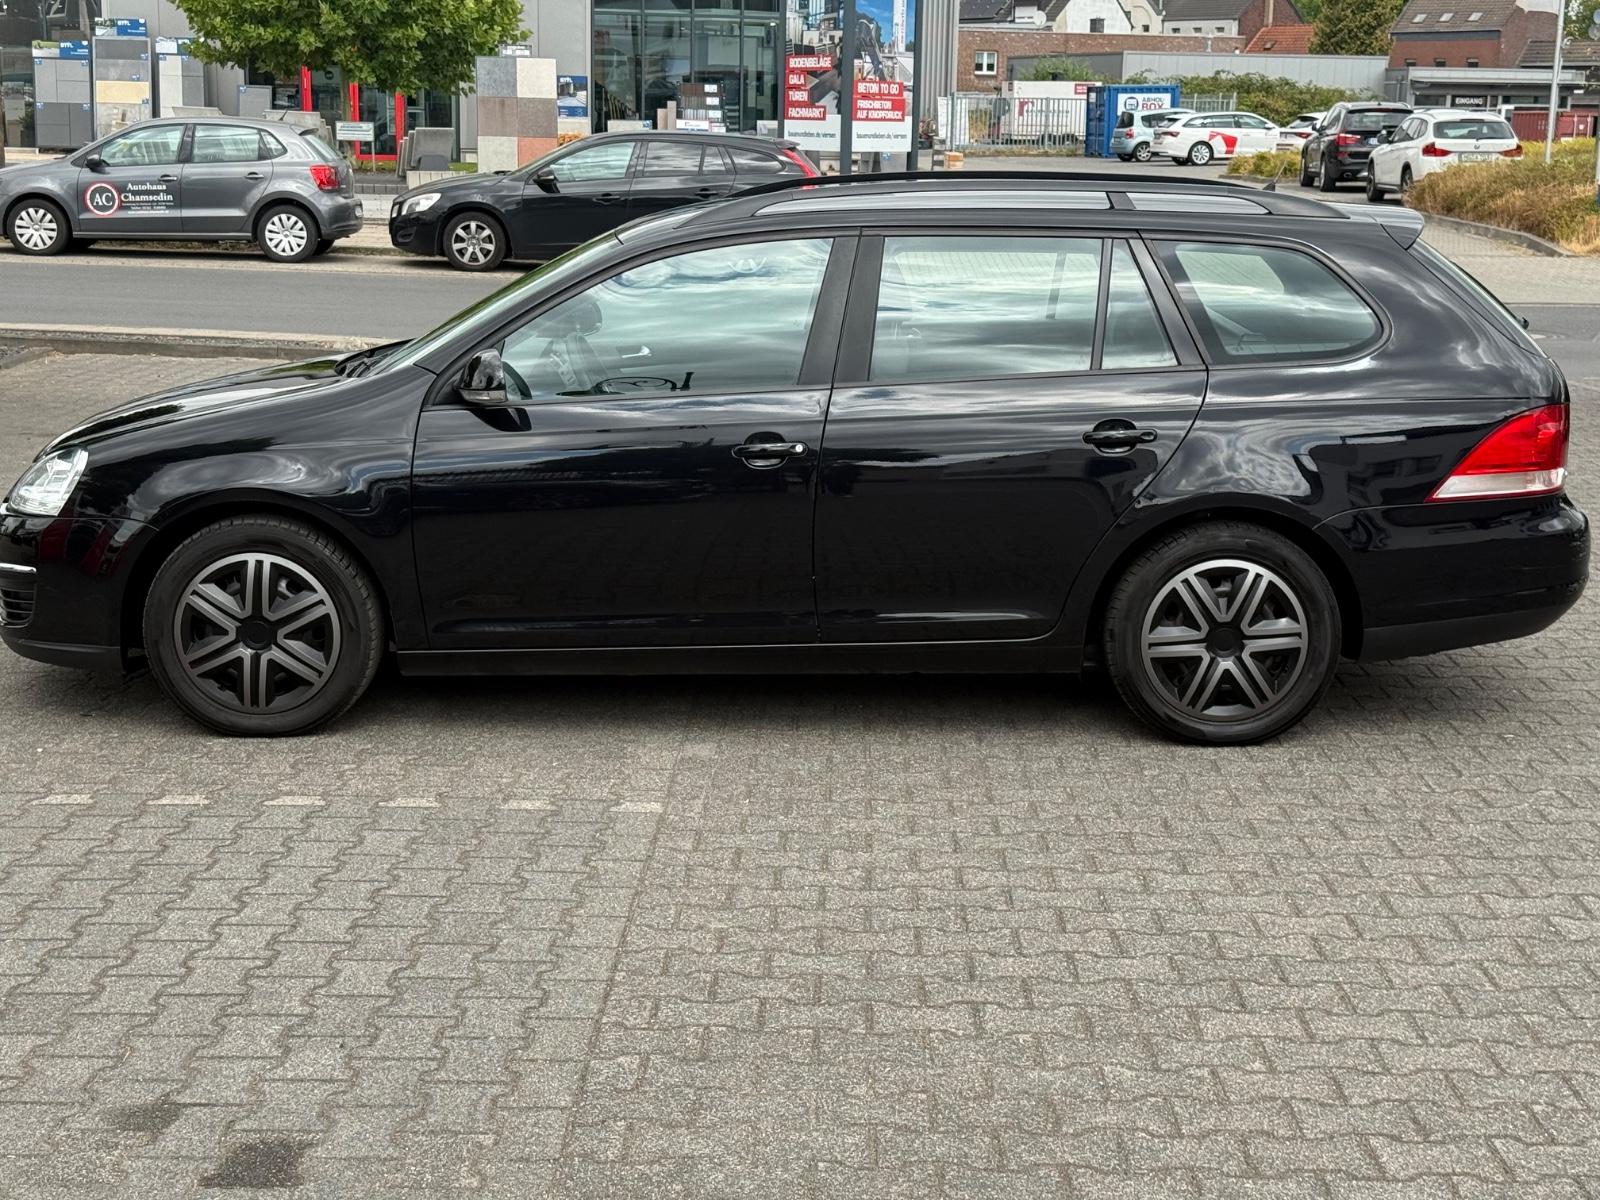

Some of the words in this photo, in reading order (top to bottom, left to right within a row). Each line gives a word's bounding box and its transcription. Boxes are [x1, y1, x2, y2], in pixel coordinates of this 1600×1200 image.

[789, 55, 832, 68] BODENBELÄGE
[788, 74, 805, 85] GALA
[857, 82, 879, 93] BETON
[880, 83, 888, 93] TO
[890, 84, 899, 94] GO
[788, 90, 808, 101] TÜREN
[857, 100, 892, 110] FRISCHBETON
[788, 107, 825, 118] FACHMARKT
[857, 110, 868, 119] AUF
[868, 110, 903, 120] KNOPFDRUCK
[126, 182, 166, 190] Autohaus
[93, 192, 113, 206] AC
[121, 192, 173, 201] Chamsedin
